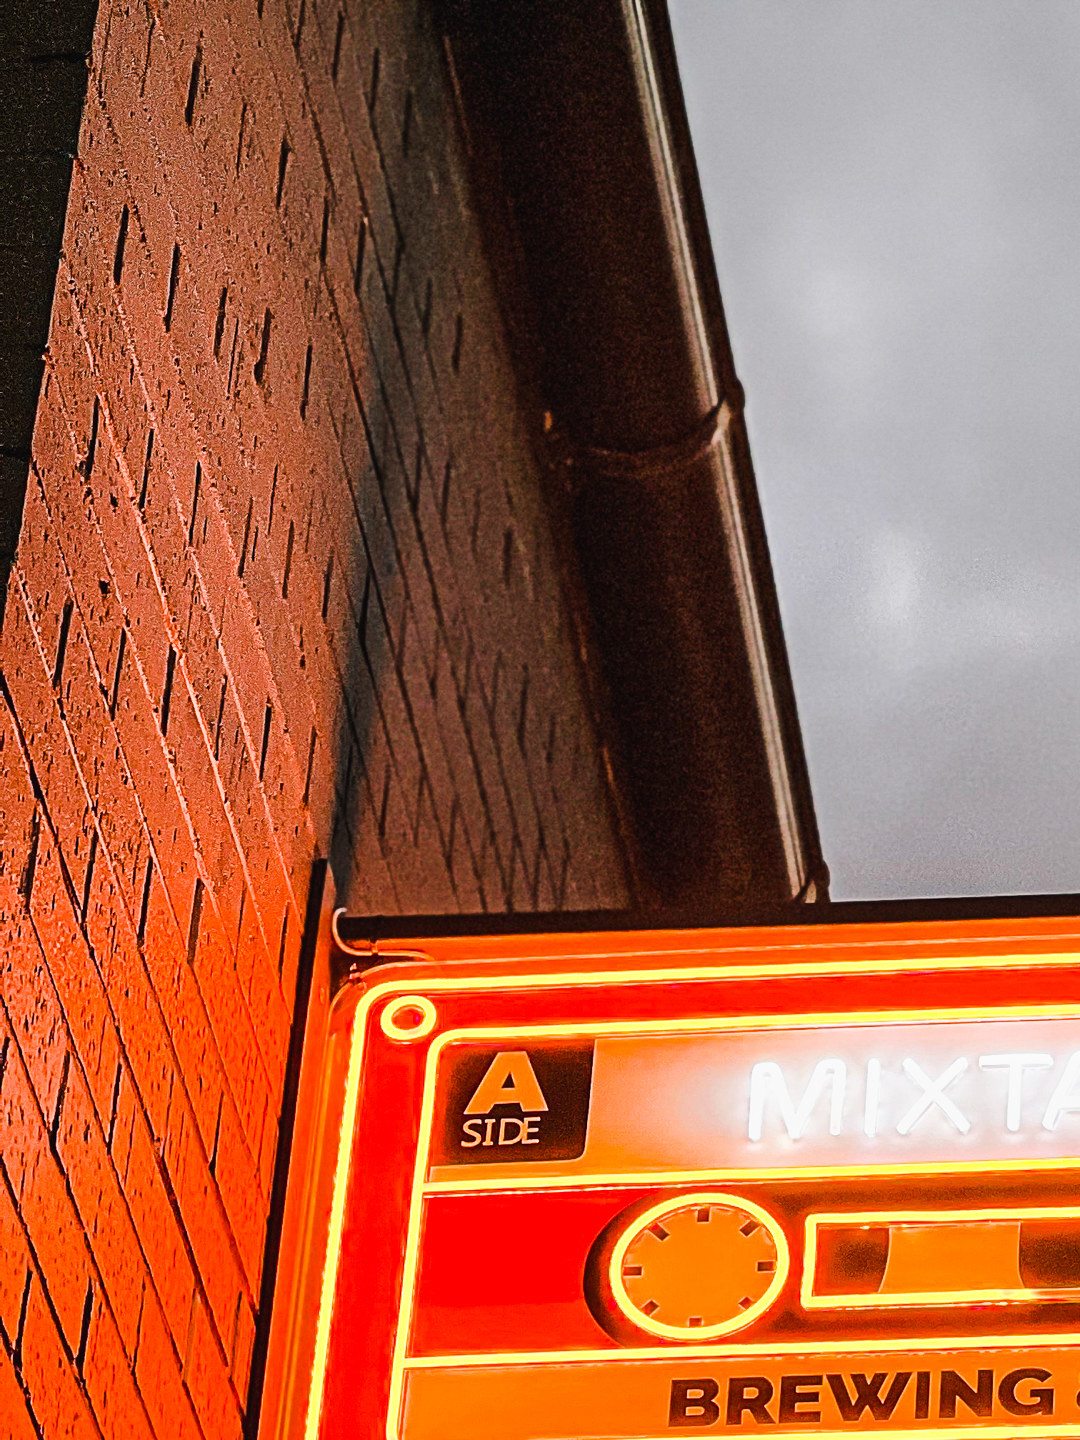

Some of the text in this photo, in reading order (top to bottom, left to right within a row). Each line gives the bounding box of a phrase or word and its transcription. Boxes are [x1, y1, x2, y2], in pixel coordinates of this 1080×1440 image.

[463, 1050, 549, 1115] A
[460, 1116, 542, 1149] SIDE
[666, 1367, 1054, 1428] BREWING
